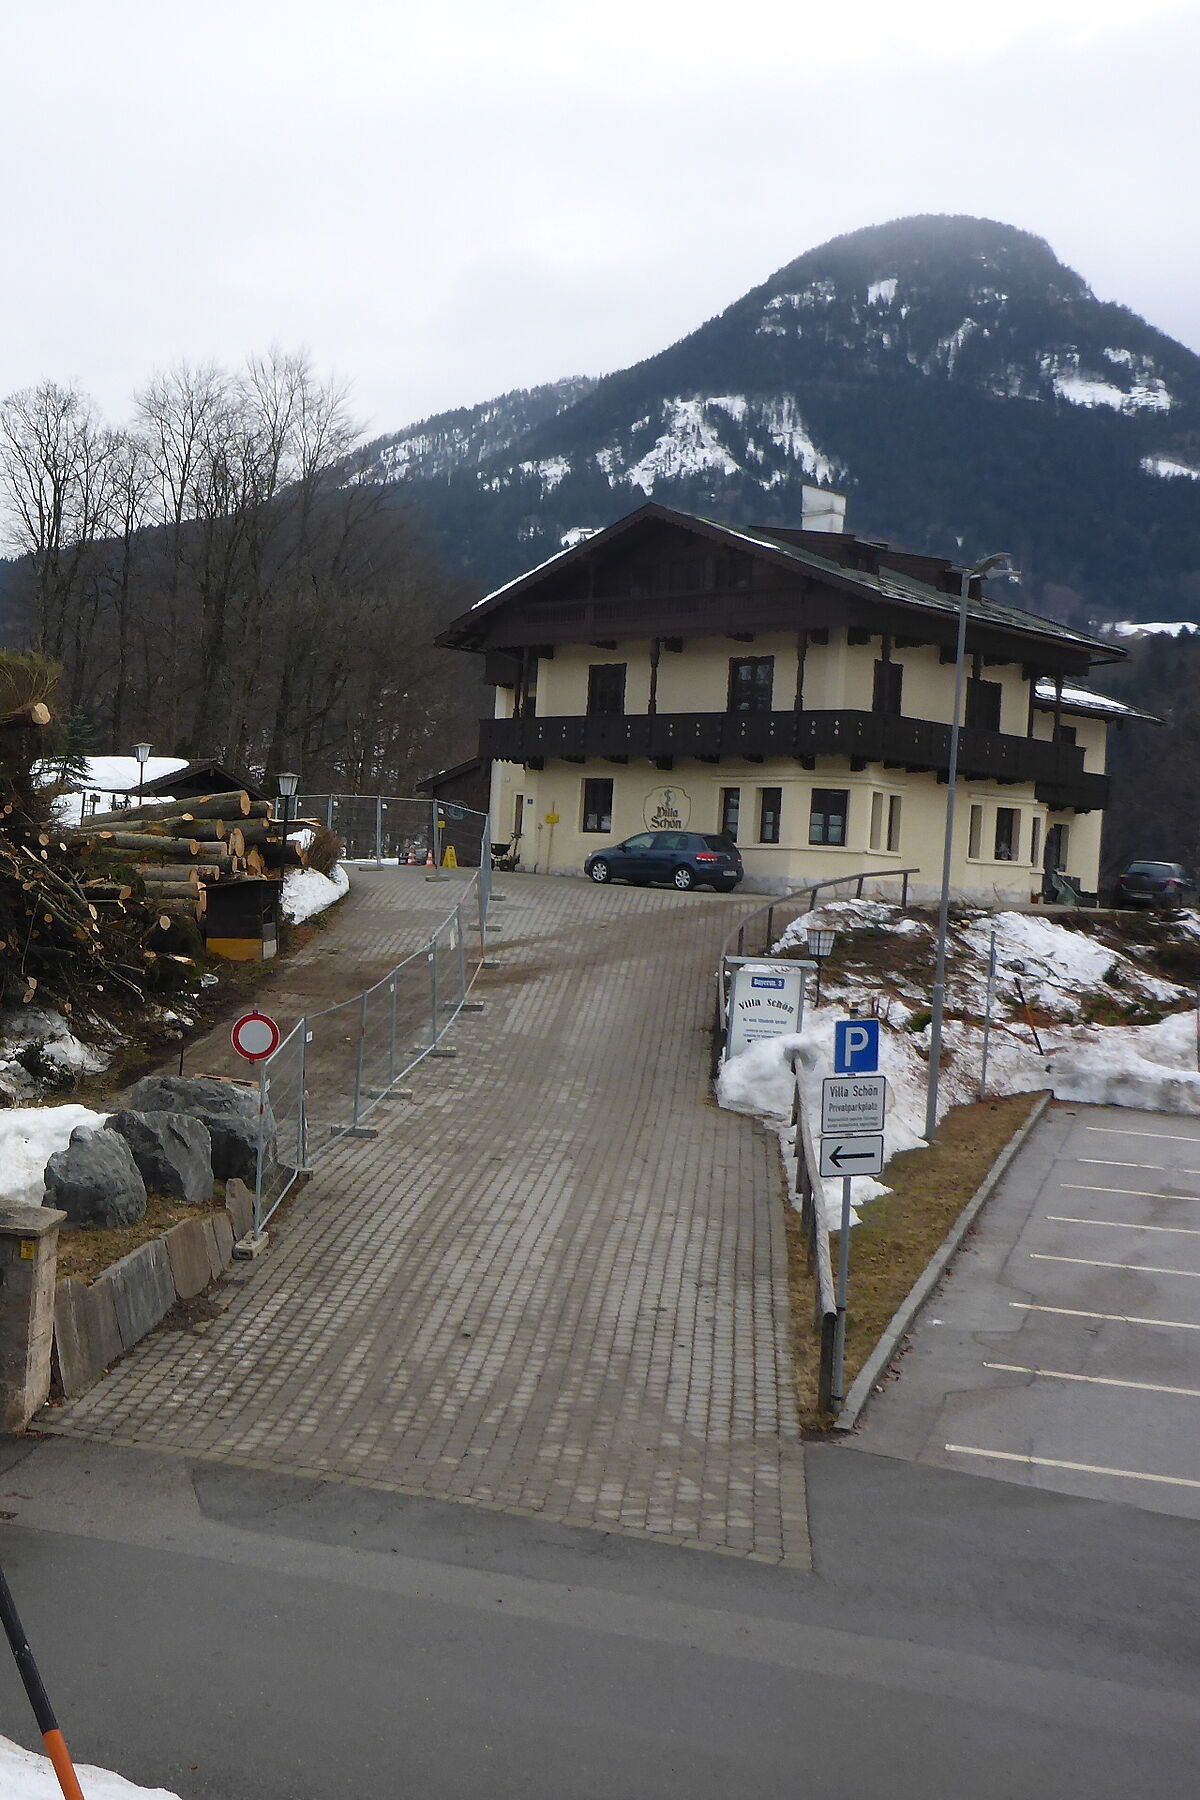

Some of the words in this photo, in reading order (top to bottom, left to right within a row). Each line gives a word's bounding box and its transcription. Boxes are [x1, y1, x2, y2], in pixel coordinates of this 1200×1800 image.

[656, 806, 679, 818] Villa
[738, 998, 761, 1010] Villa
[766, 998, 795, 1014] Schön
[844, 1026, 869, 1067] P
[830, 1086, 849, 1098] Villa
[852, 1084, 878, 1097] Schön
[828, 1102, 878, 1114] Privatparkplatz
